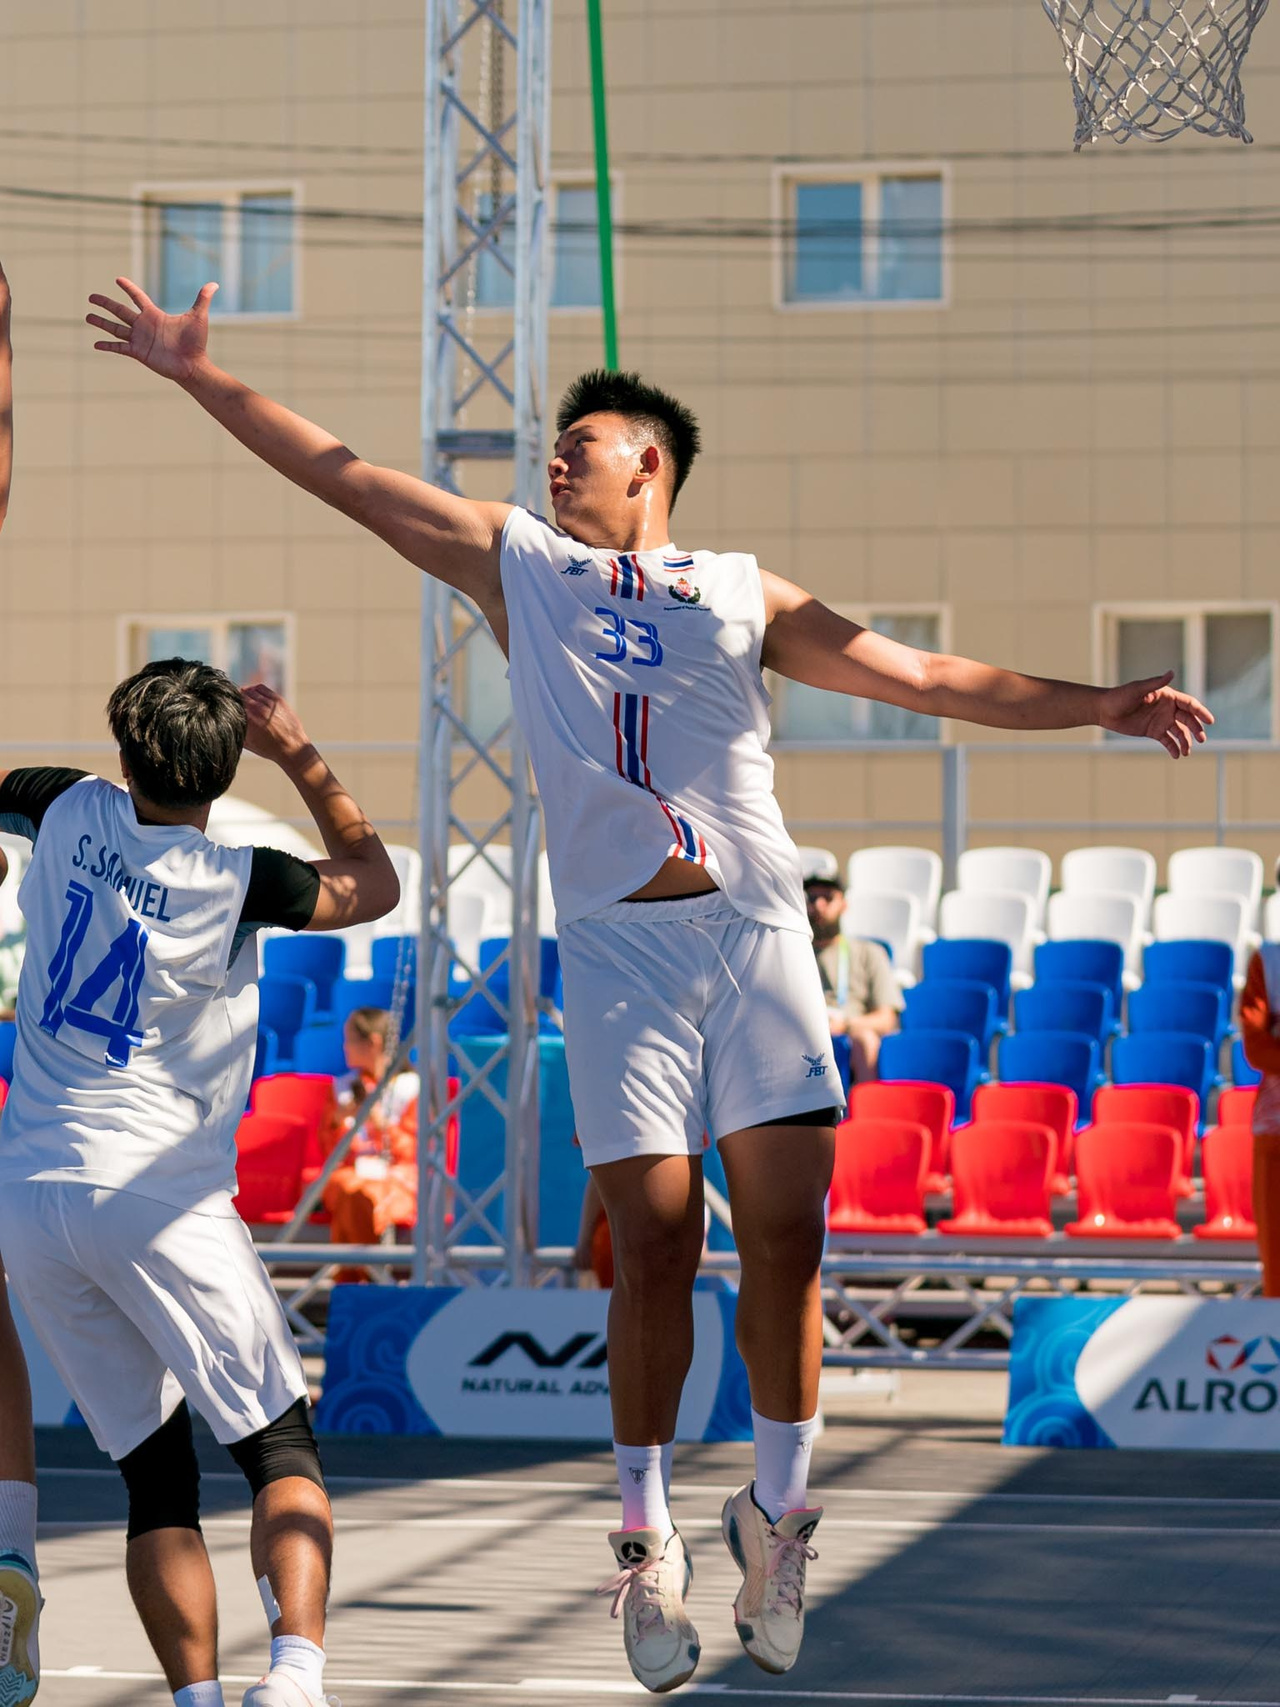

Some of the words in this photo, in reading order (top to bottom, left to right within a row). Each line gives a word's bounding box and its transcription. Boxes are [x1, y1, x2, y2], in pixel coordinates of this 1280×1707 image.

[595, 606, 664, 668] 33
[39, 879, 152, 1068] 14
[461, 1377, 561, 1394] NATURAL
